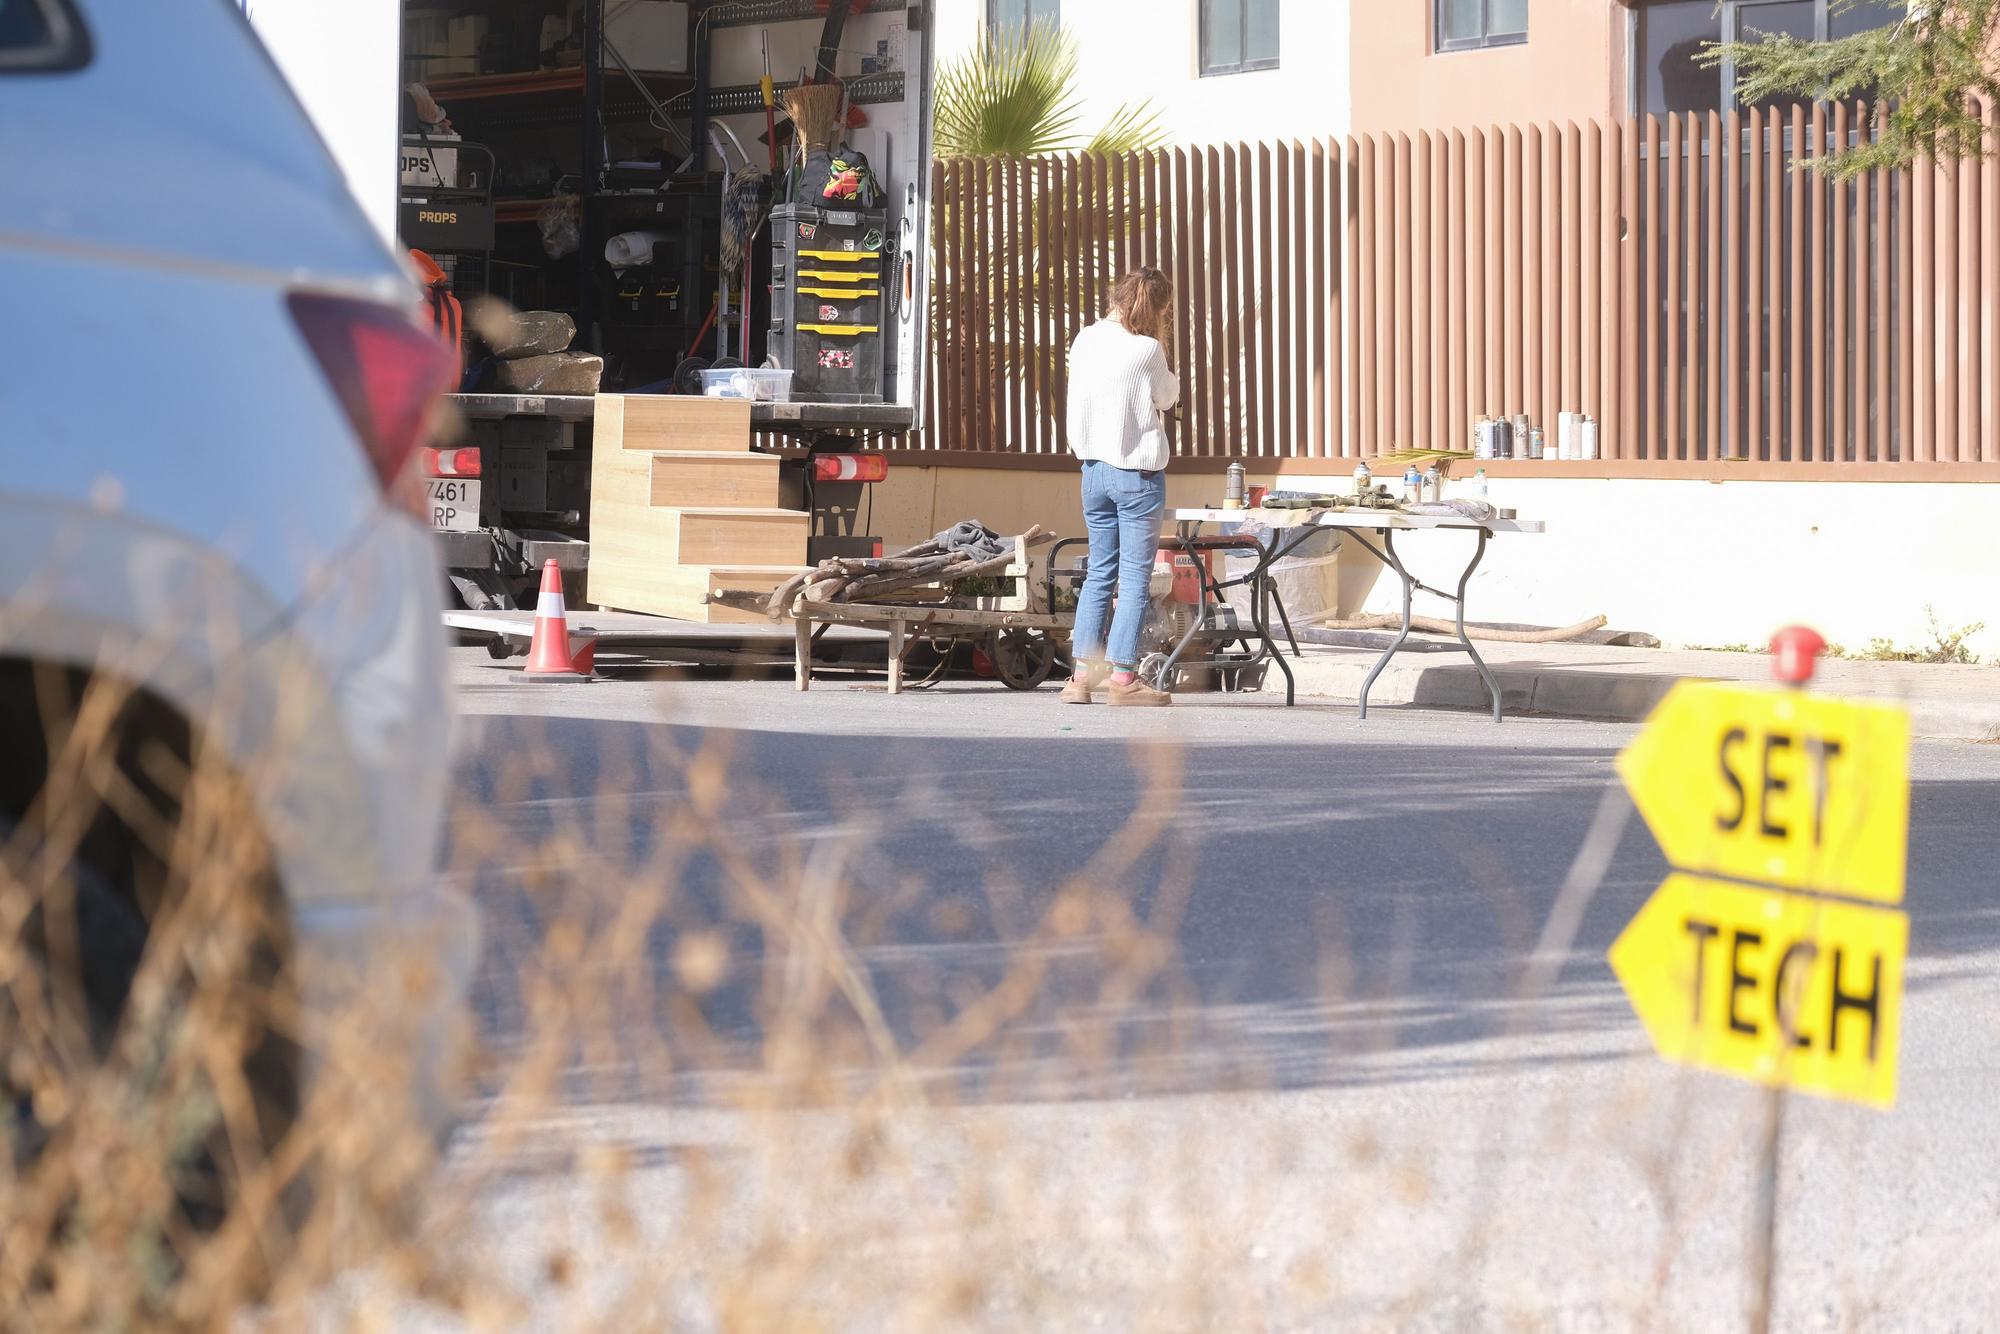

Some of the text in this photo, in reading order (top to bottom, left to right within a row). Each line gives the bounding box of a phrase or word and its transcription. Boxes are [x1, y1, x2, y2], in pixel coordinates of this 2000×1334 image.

[419, 211, 457, 223] PROPS
[425, 482, 466, 502] 7461
[1714, 727, 1843, 846] SET
[1683, 919, 1882, 1061] TECH
